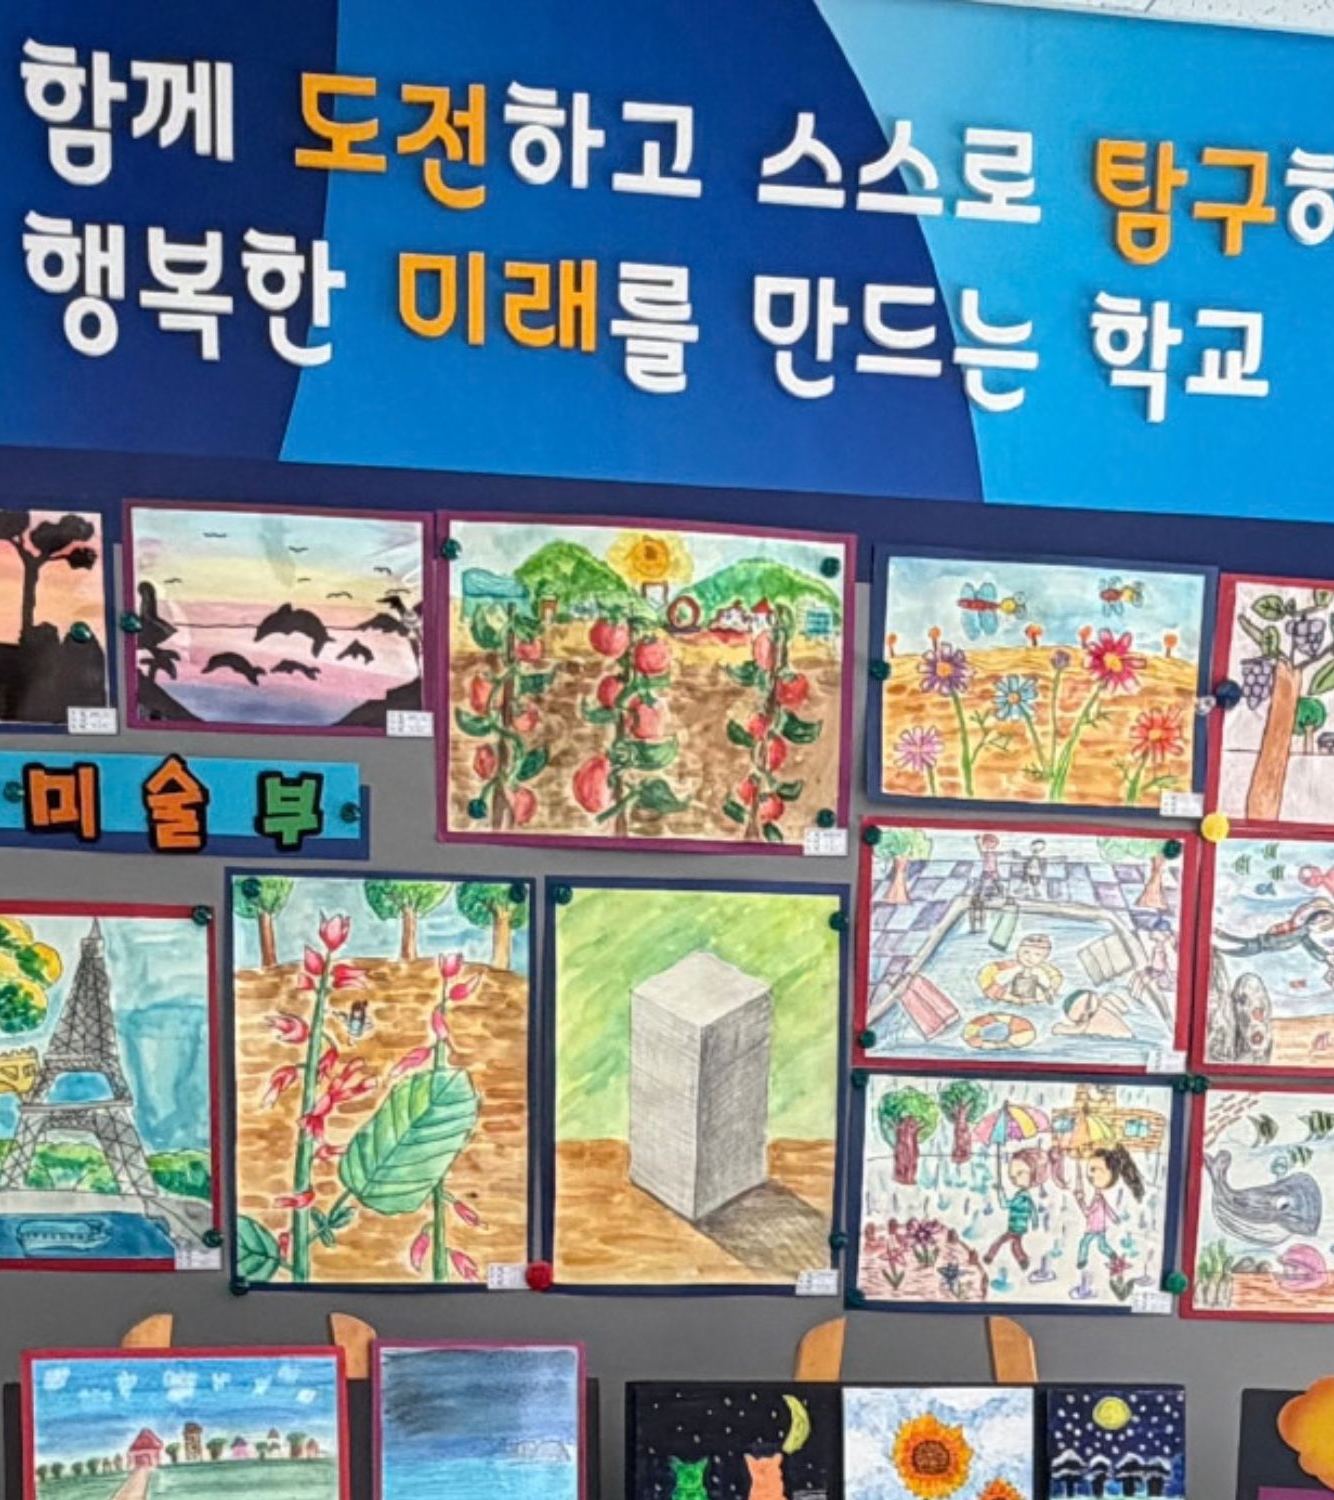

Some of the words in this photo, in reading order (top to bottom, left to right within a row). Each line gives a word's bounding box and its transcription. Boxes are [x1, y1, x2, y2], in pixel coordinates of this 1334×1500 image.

[21, 39, 233, 186] 함께
[295, 72, 702, 210] 도전하고
[757, 112, 1041, 224] 스스로
[22, 210, 346, 368] 행복한
[399, 251, 699, 395] 미래를
[753, 275, 1039, 412] 만드는
[1090, 292, 1270, 424] 학교
[23, 754, 323, 853] 미술부
